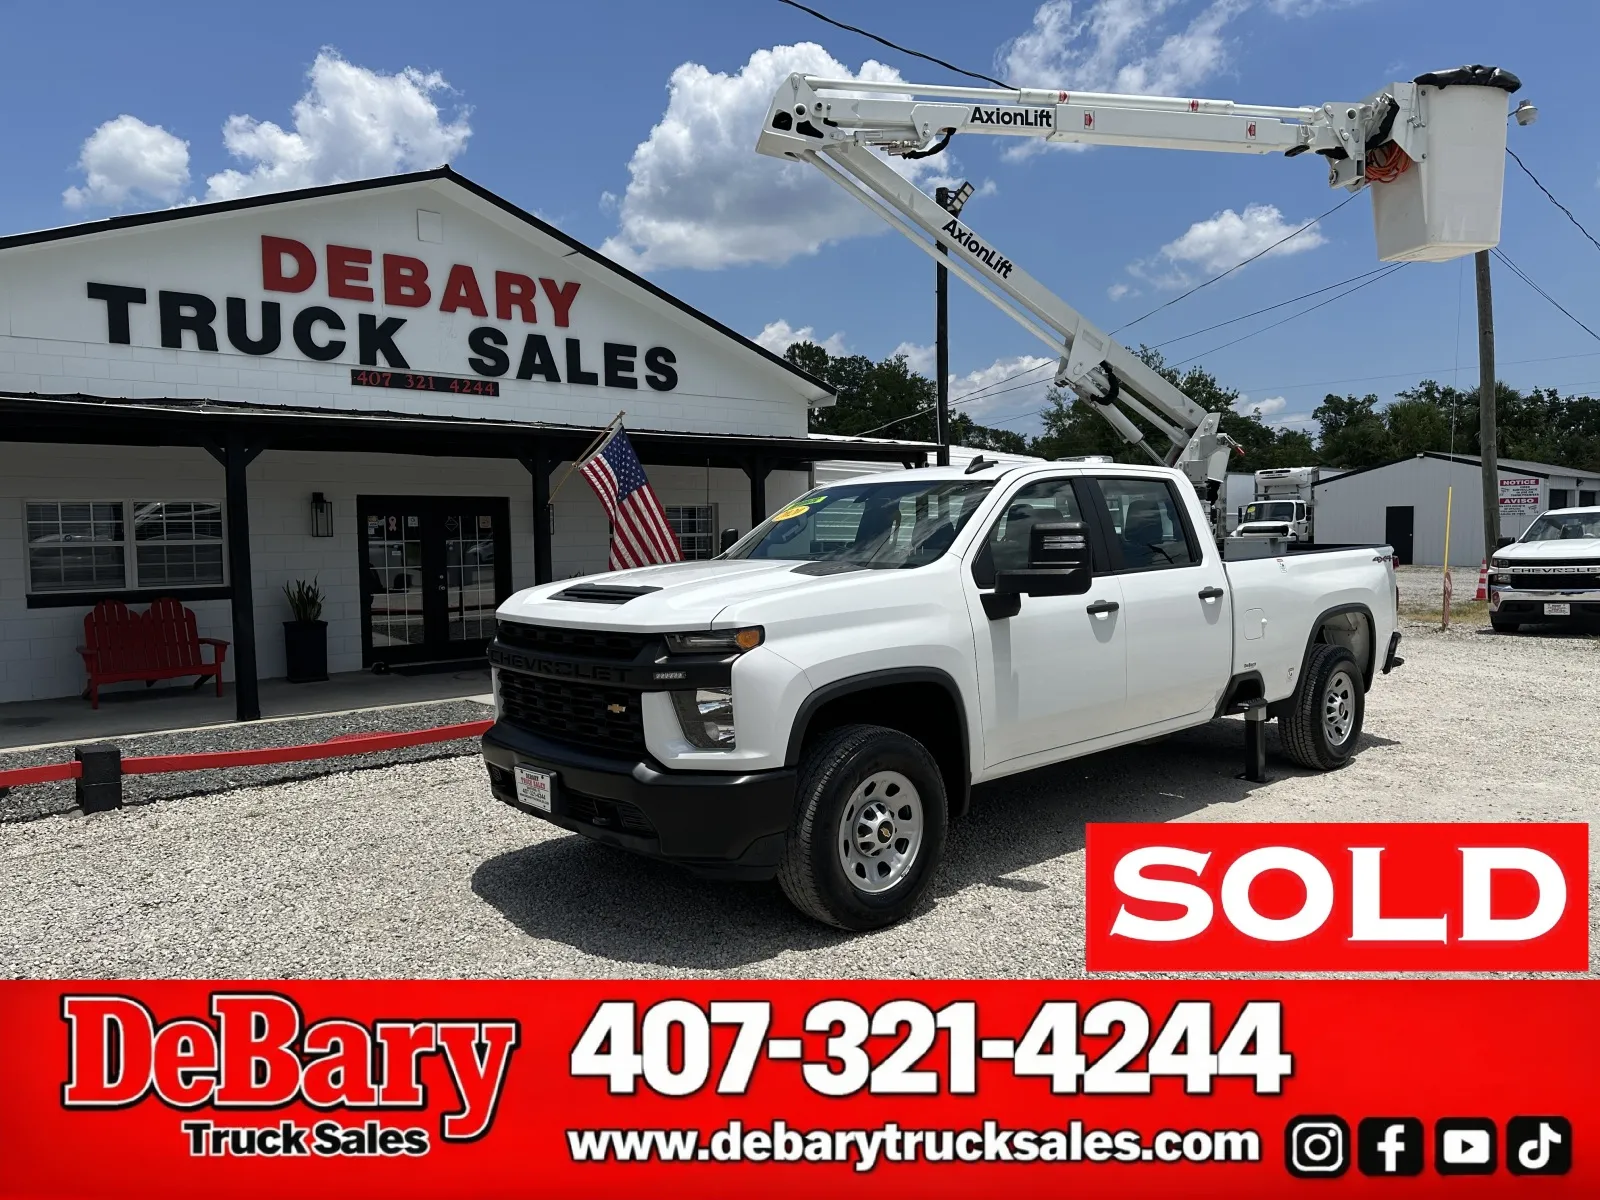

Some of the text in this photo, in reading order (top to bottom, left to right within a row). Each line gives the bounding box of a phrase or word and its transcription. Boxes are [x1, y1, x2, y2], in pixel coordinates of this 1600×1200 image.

[970, 106, 1052, 128] AxionLift
[941, 219, 1013, 280] AxionLift
[262, 236, 580, 327] DEBARY
[87, 282, 679, 392] TRUCK SALES
[357, 371, 496, 395] 407 321 4244
[490, 650, 633, 682] CHEVROLET
